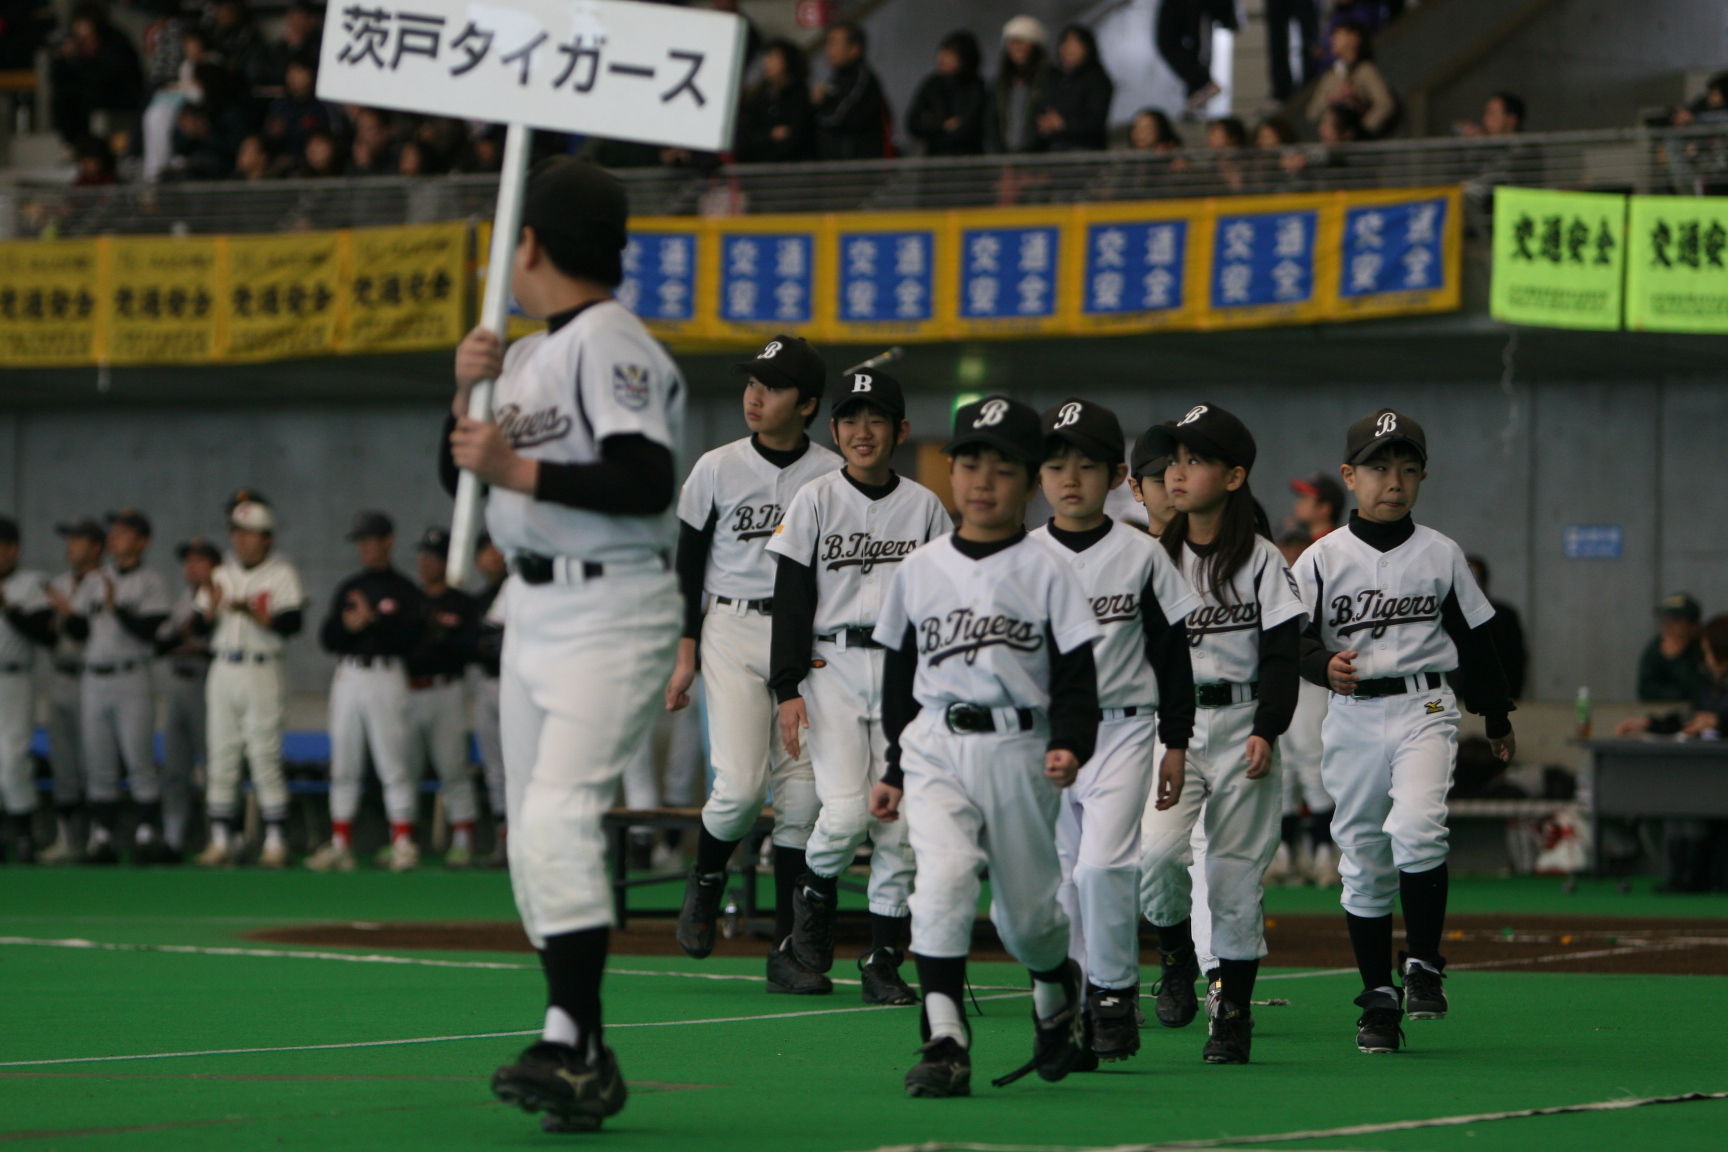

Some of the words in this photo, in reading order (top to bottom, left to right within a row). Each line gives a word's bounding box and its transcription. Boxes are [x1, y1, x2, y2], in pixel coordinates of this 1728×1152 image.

[337, 4, 707, 107] 茨戸タイガース
[757, 341, 783, 360] B
[852, 373, 873, 393] B
[972, 399, 1010, 430] B
[1053, 402, 1083, 430] B
[1176, 404, 1209, 428] B
[1374, 412, 1398, 438] B
[821, 532, 918, 576] B.Tigers
[1329, 589, 1439, 639] B.Tigers
[919, 606, 1038, 666] B.Tigers
